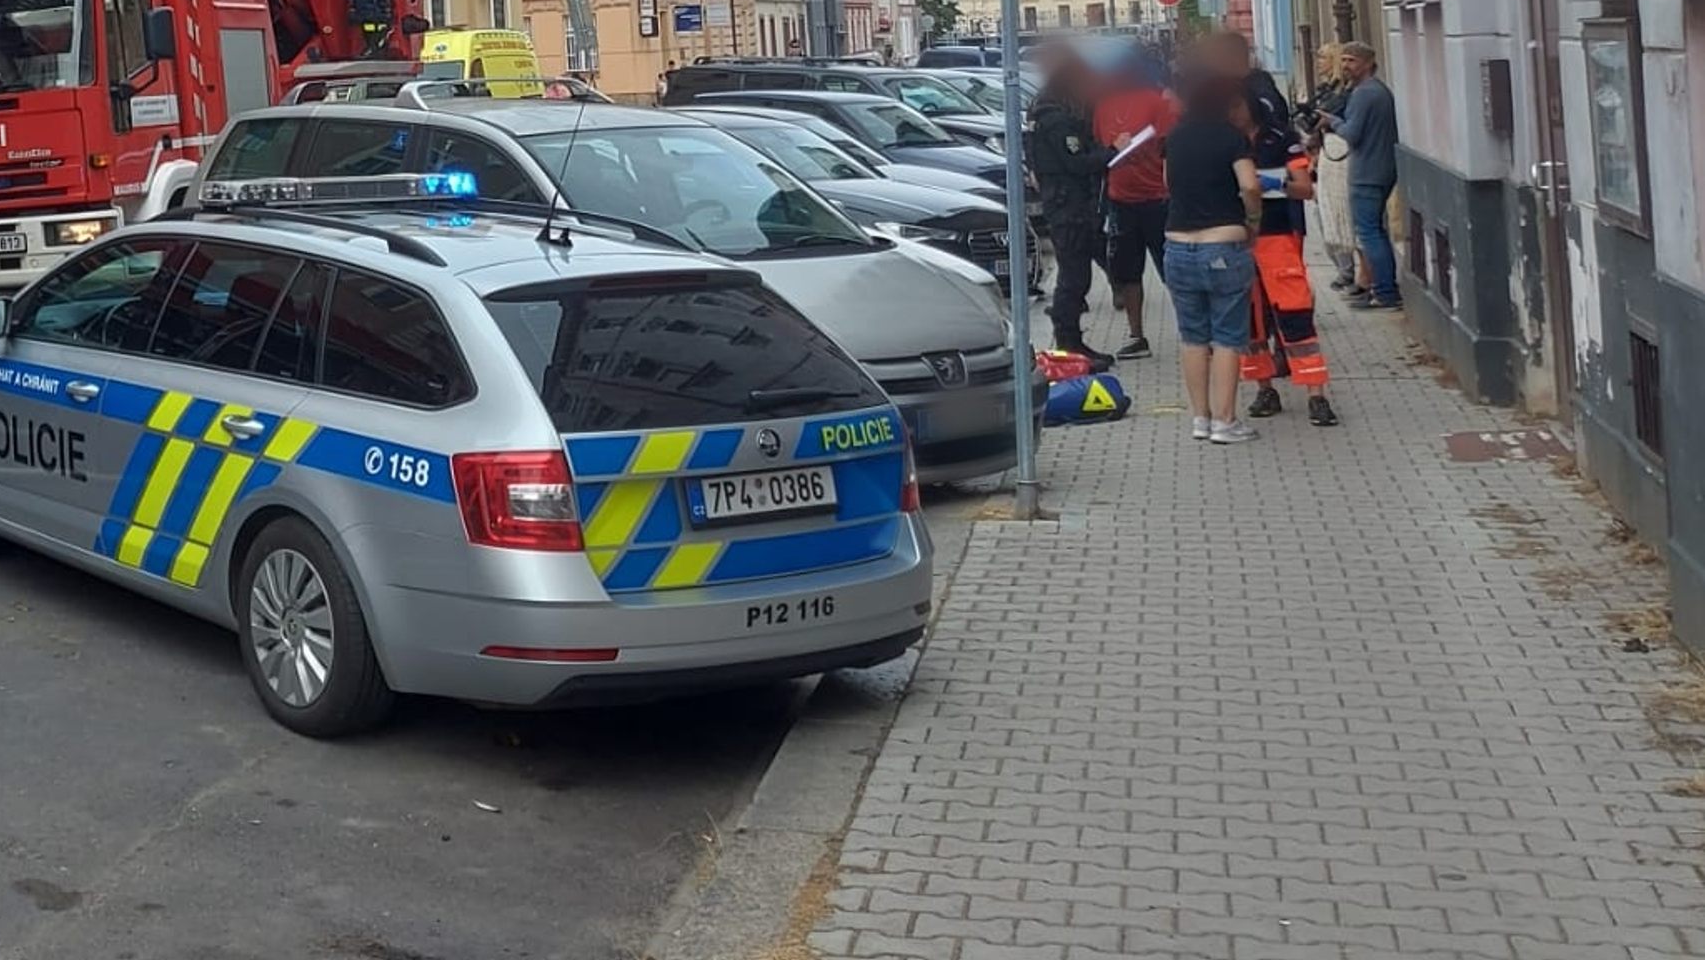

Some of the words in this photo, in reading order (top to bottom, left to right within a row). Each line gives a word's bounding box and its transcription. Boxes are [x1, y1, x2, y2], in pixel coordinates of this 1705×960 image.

[821, 417, 894, 451] POLICIE
[389, 452, 430, 487] 158
[708, 479, 753, 514] 7P4
[769, 471, 825, 506] 0386
[746, 602, 788, 628] P12
[797, 596, 834, 620] 116
